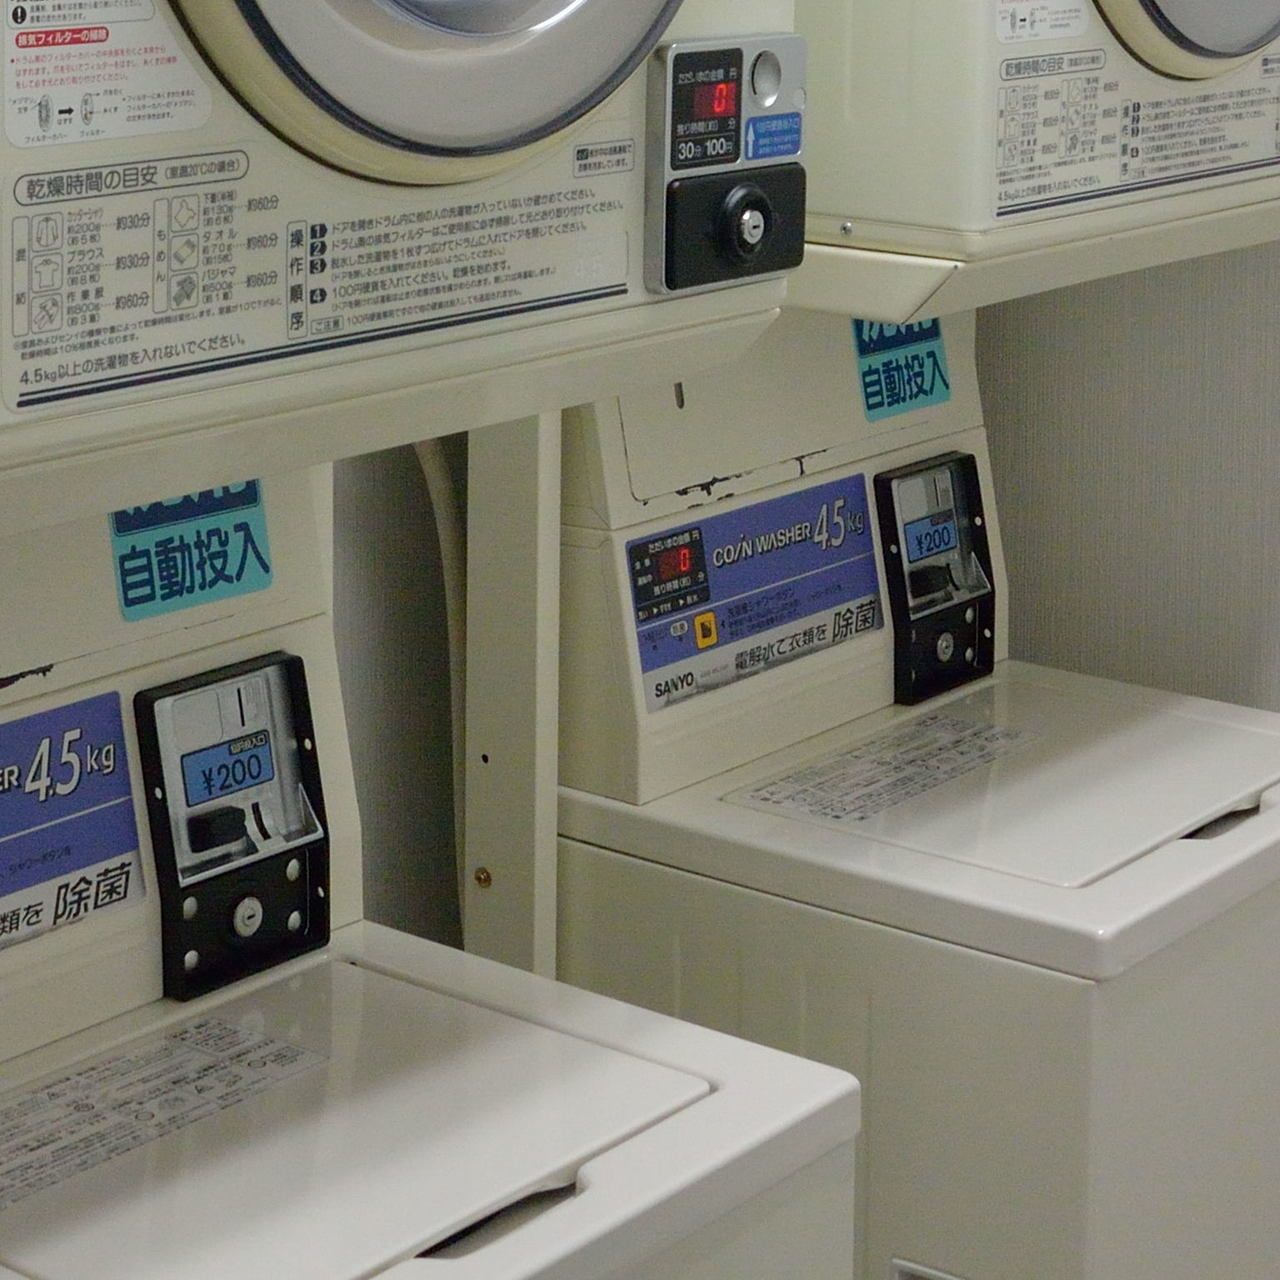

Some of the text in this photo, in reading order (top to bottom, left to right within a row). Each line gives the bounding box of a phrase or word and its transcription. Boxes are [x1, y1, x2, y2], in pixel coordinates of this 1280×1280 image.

[26, 165, 158, 199] 乾燥時間の目安
[67, 247, 105, 263] ブラウス
[202, 228, 238, 242] タオル
[289, 228, 305, 332] 操作順序
[19, 332, 247, 386] 4.5kg以上の洗濯物を入れないでください。
[862, 350, 949, 411] 自動投入
[756, 522, 811, 553] WASHER
[916, 524, 952, 556] ¥200
[119, 521, 270, 608] 自動投入
[734, 599, 876, 672] 電解水で衣類を 除菌
[654, 671, 695, 699] SANYO
[201, 753, 263, 797] ¥200
[52, 861, 133, 926] 除菌
